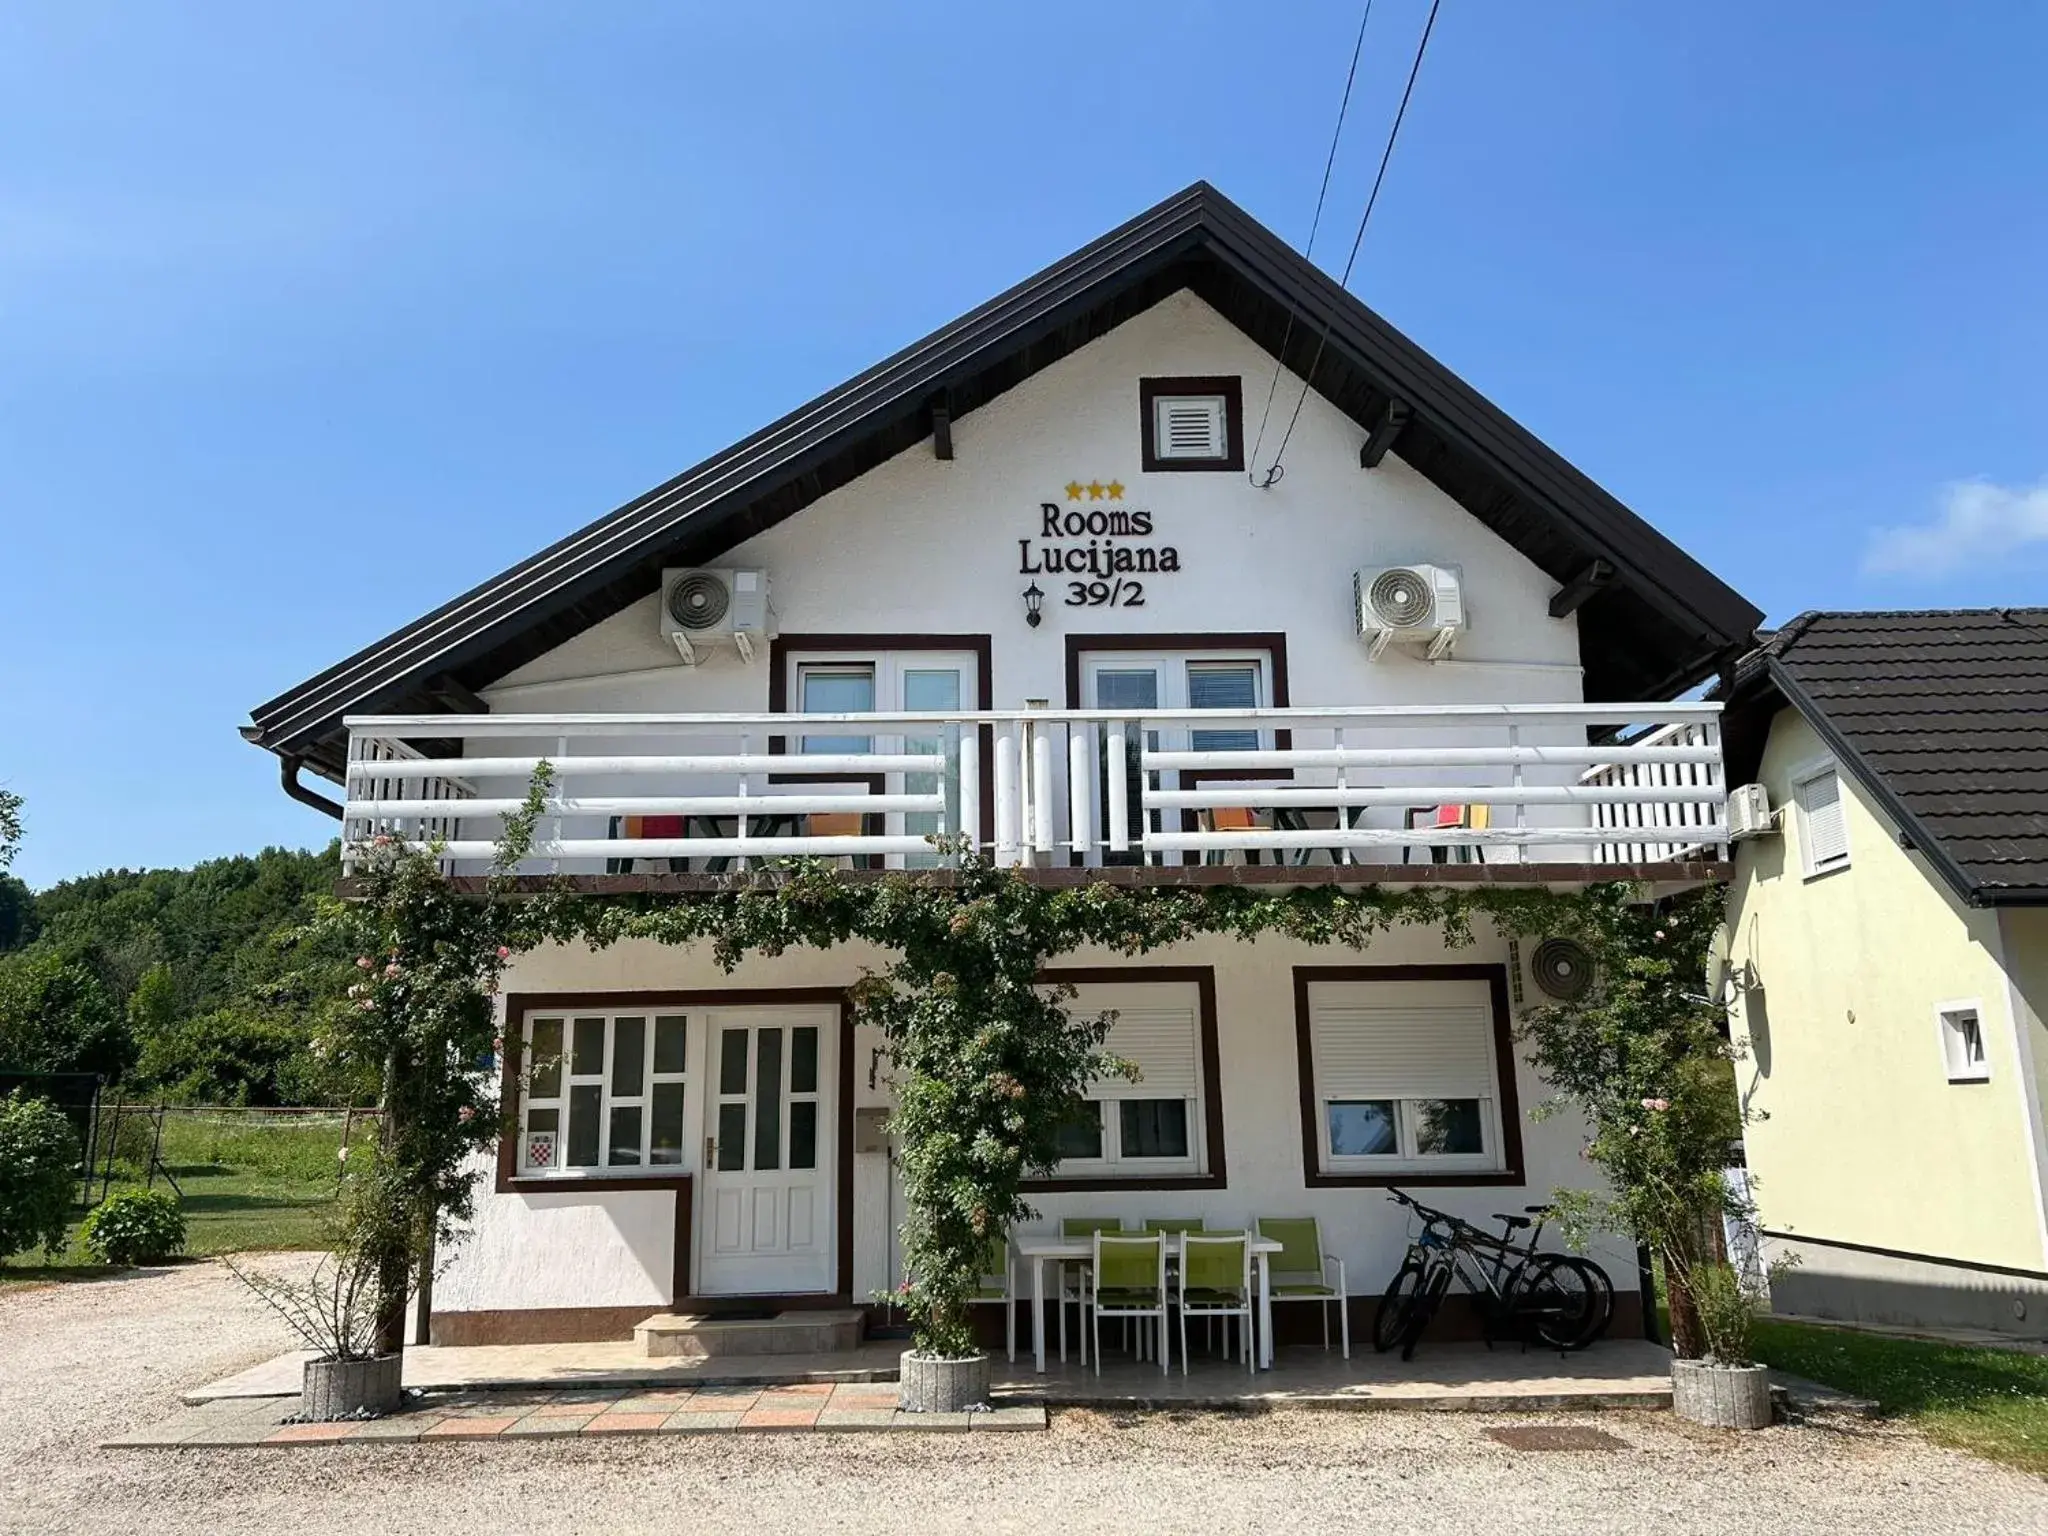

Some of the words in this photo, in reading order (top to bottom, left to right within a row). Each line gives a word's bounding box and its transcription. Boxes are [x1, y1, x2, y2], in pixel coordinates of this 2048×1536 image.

[1040, 503, 1153, 537] Rooms
[1018, 539, 1181, 579] Lucijana
[1064, 577, 1145, 607] 39/2
